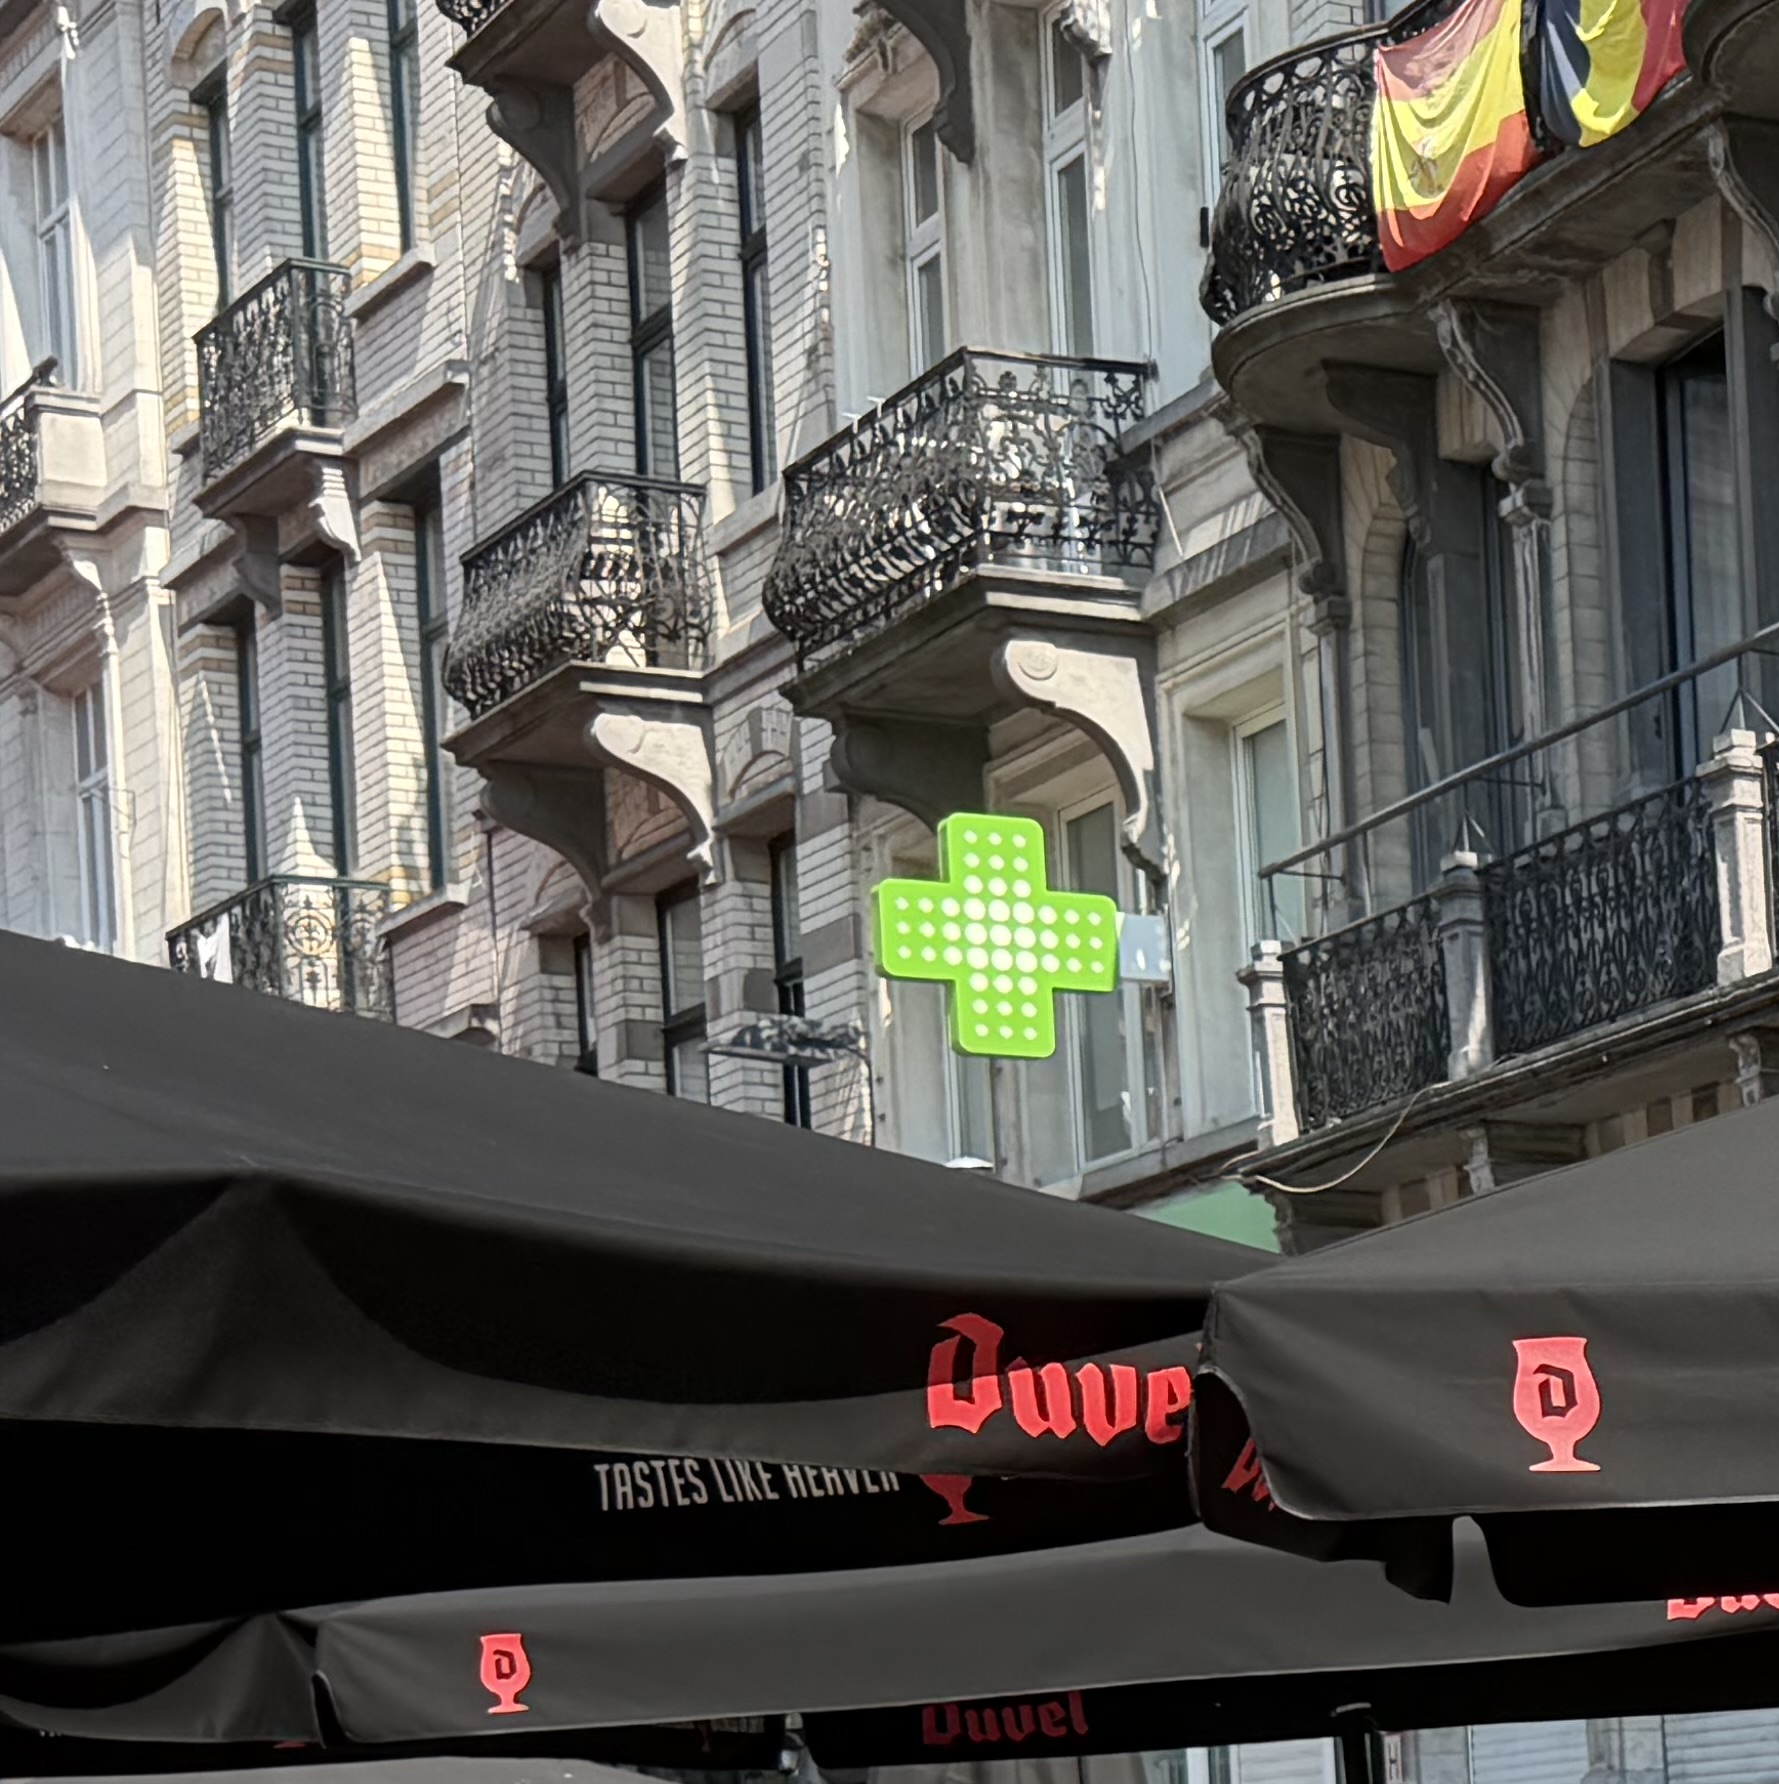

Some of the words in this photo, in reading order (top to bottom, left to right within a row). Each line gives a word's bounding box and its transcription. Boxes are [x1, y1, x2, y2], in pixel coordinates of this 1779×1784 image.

[928, 1312, 1204, 1447] Duve
[594, 1459, 707, 1511] TASTES
[713, 1459, 780, 1503] LIKE
[921, 1690, 1089, 1745] Duvel
